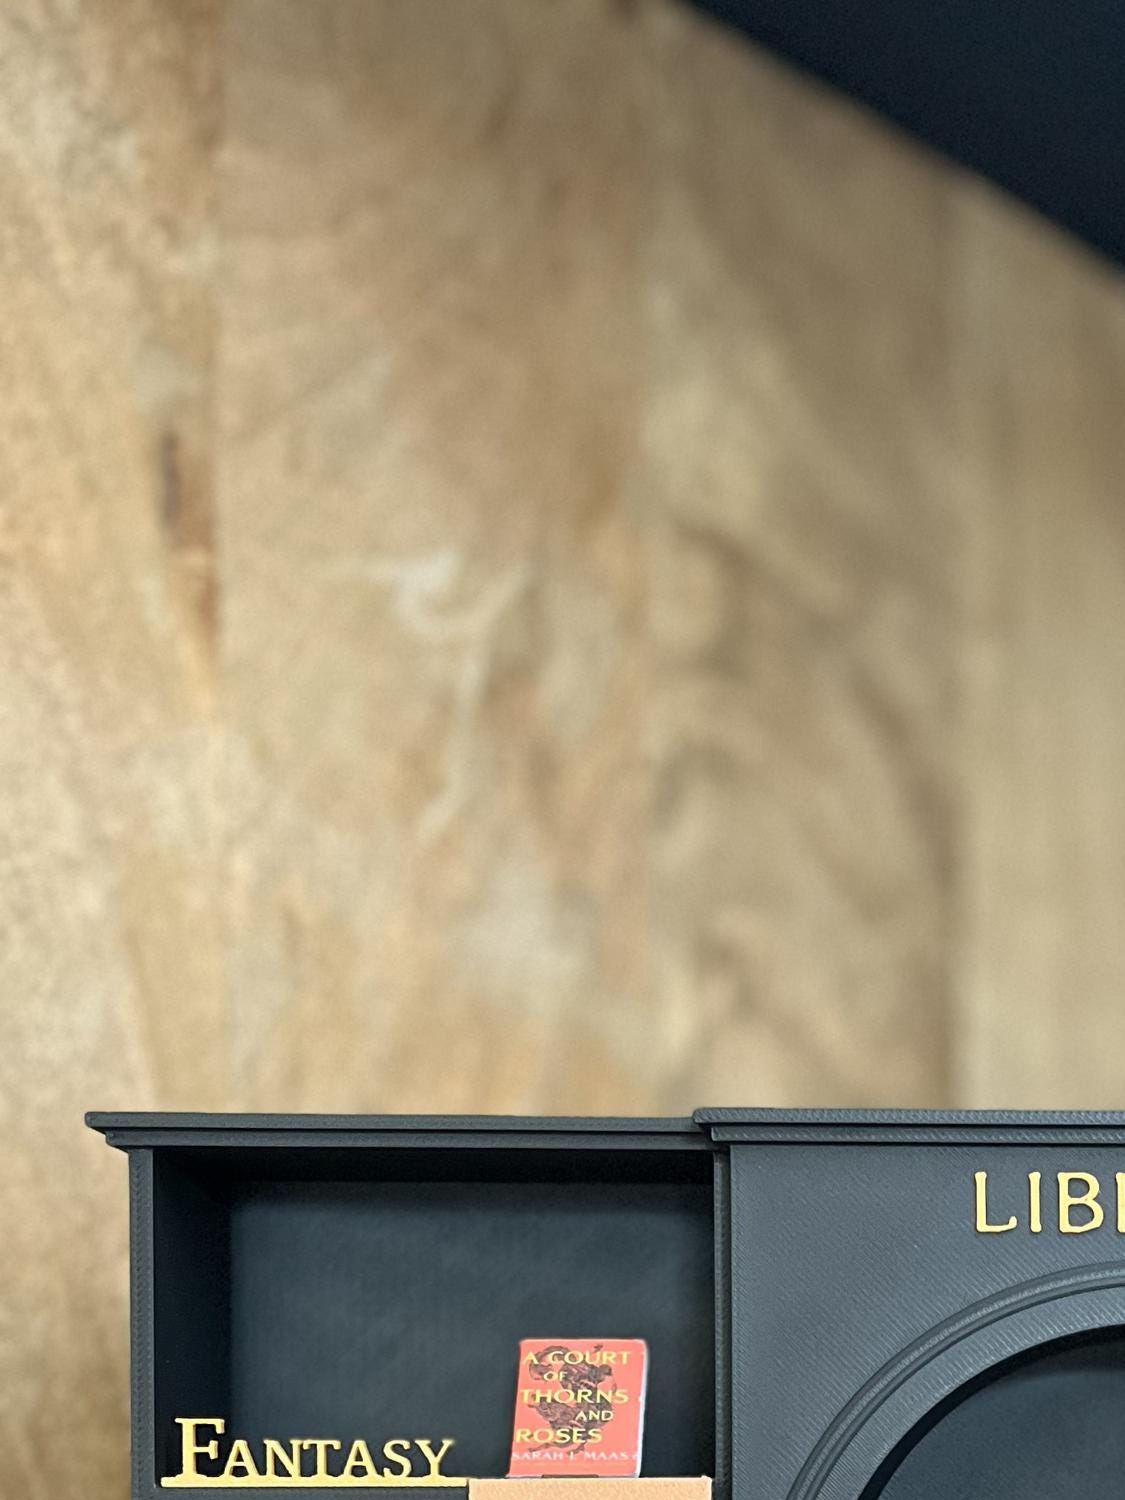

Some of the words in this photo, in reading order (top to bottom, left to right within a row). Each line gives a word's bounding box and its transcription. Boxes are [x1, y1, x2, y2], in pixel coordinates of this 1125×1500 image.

[523, 1352, 539, 1364] A
[549, 1351, 631, 1365] COURT
[543, 1371, 568, 1381] OF
[520, 1389, 629, 1404] THORNS
[575, 1410, 614, 1421] AND
[516, 1428, 603, 1443] ROSES
[174, 1416, 455, 1479] FANTASY
[583, 1452, 629, 1460] MAAS
